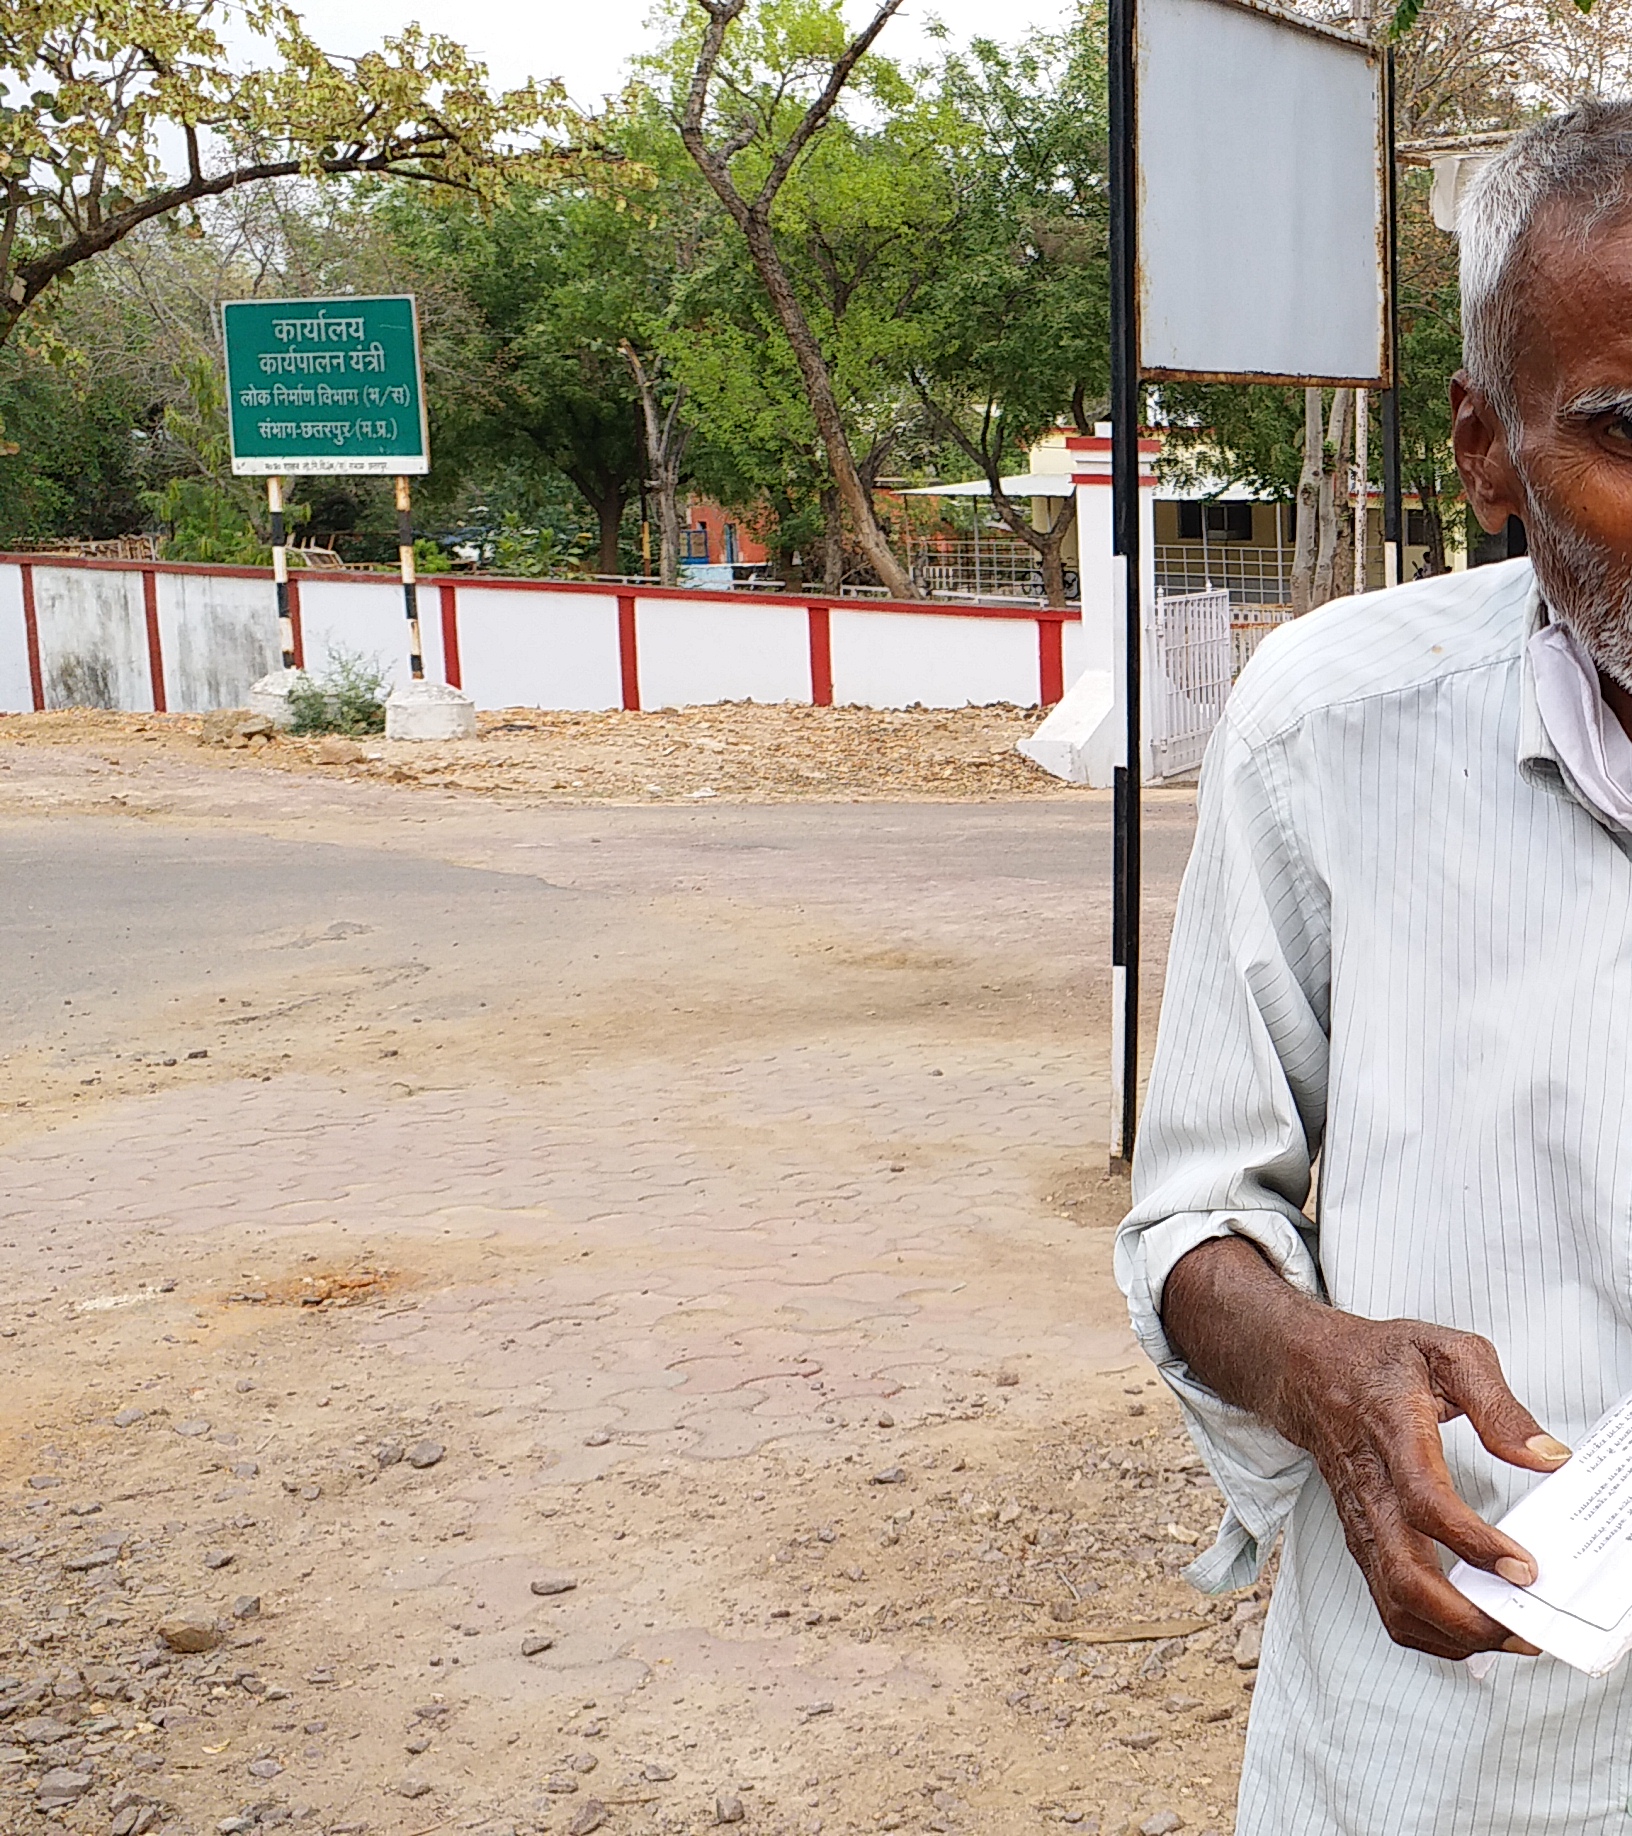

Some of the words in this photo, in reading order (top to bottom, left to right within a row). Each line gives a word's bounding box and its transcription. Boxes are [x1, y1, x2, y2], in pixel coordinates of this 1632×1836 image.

[272, 309, 365, 342] कार्यालय
[258, 345, 345, 375] कार्यपालन
[348, 342, 385, 372] यंत्री
[239, 384, 271, 406] लोक
[273, 383, 315, 406] निर्माण
[317, 384, 358, 406] विभाग
